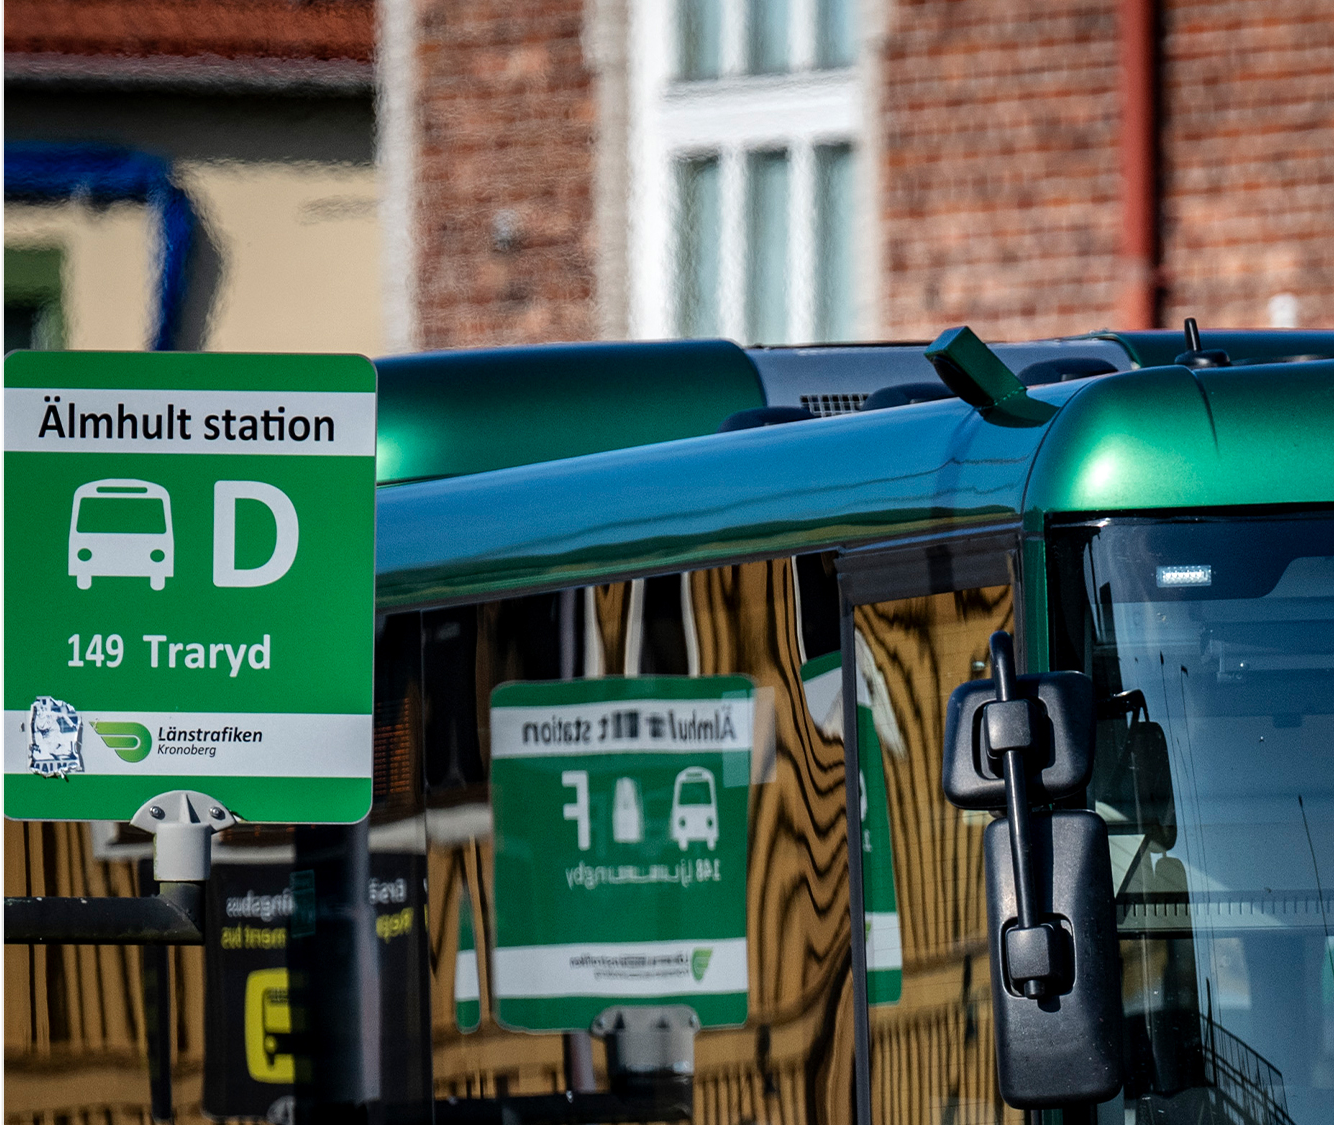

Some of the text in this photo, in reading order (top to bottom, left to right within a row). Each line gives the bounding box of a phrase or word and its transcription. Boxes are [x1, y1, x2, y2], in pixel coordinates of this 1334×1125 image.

[39, 396, 335, 442] Älmhult station
[213, 480, 299, 588] D
[67, 634, 271, 677] 149 Traryd
[157, 744, 216, 758] Kronoberg
[158, 726, 263, 742] Länstrafiken
